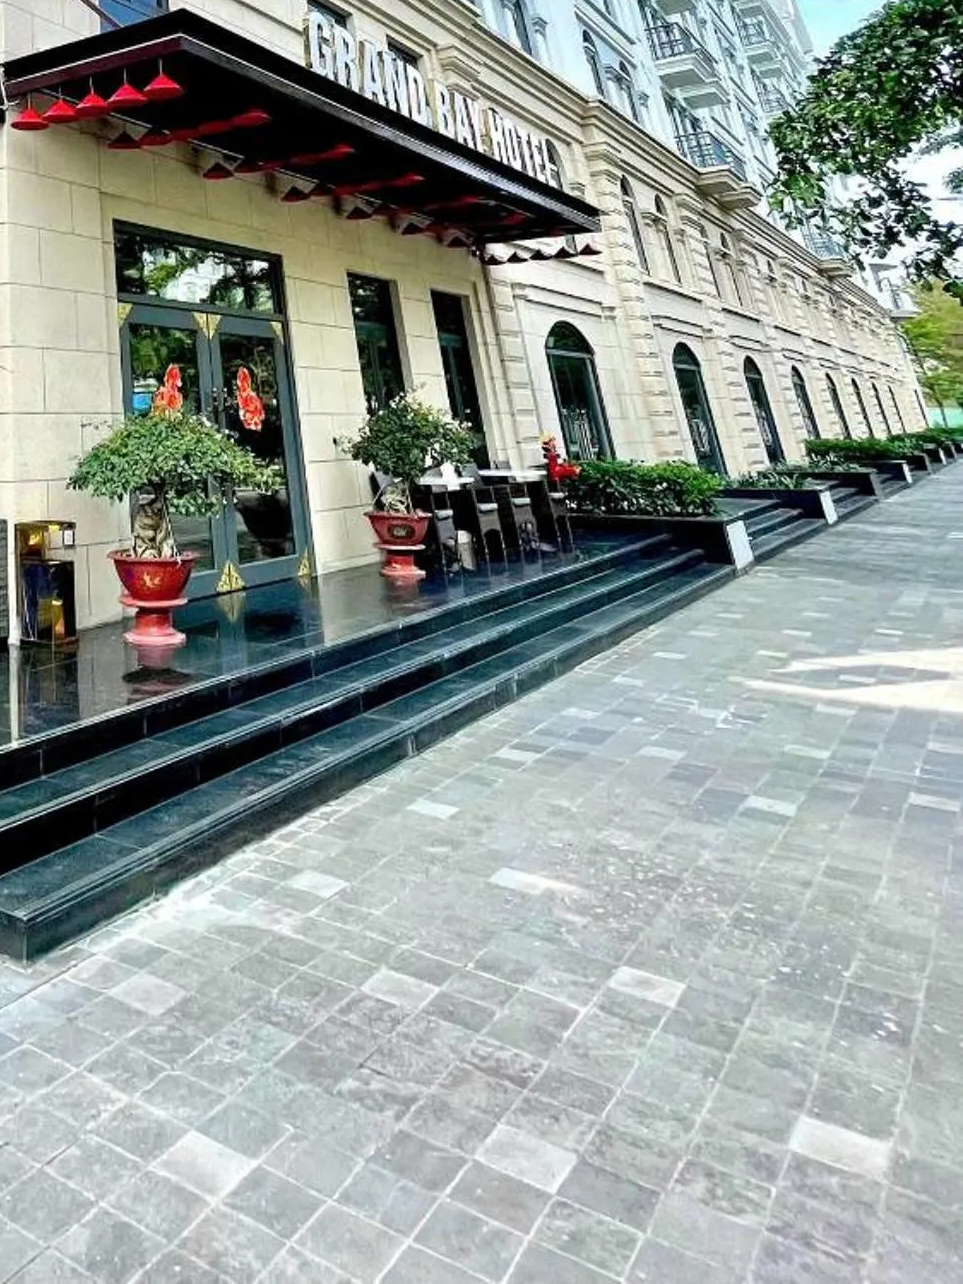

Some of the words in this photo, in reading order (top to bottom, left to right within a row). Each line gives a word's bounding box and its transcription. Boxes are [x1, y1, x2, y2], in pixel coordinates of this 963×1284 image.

[307, 10, 432, 126] GRAND
[434, 79, 483, 154] BAY
[487, 107, 560, 190] HOTEL
